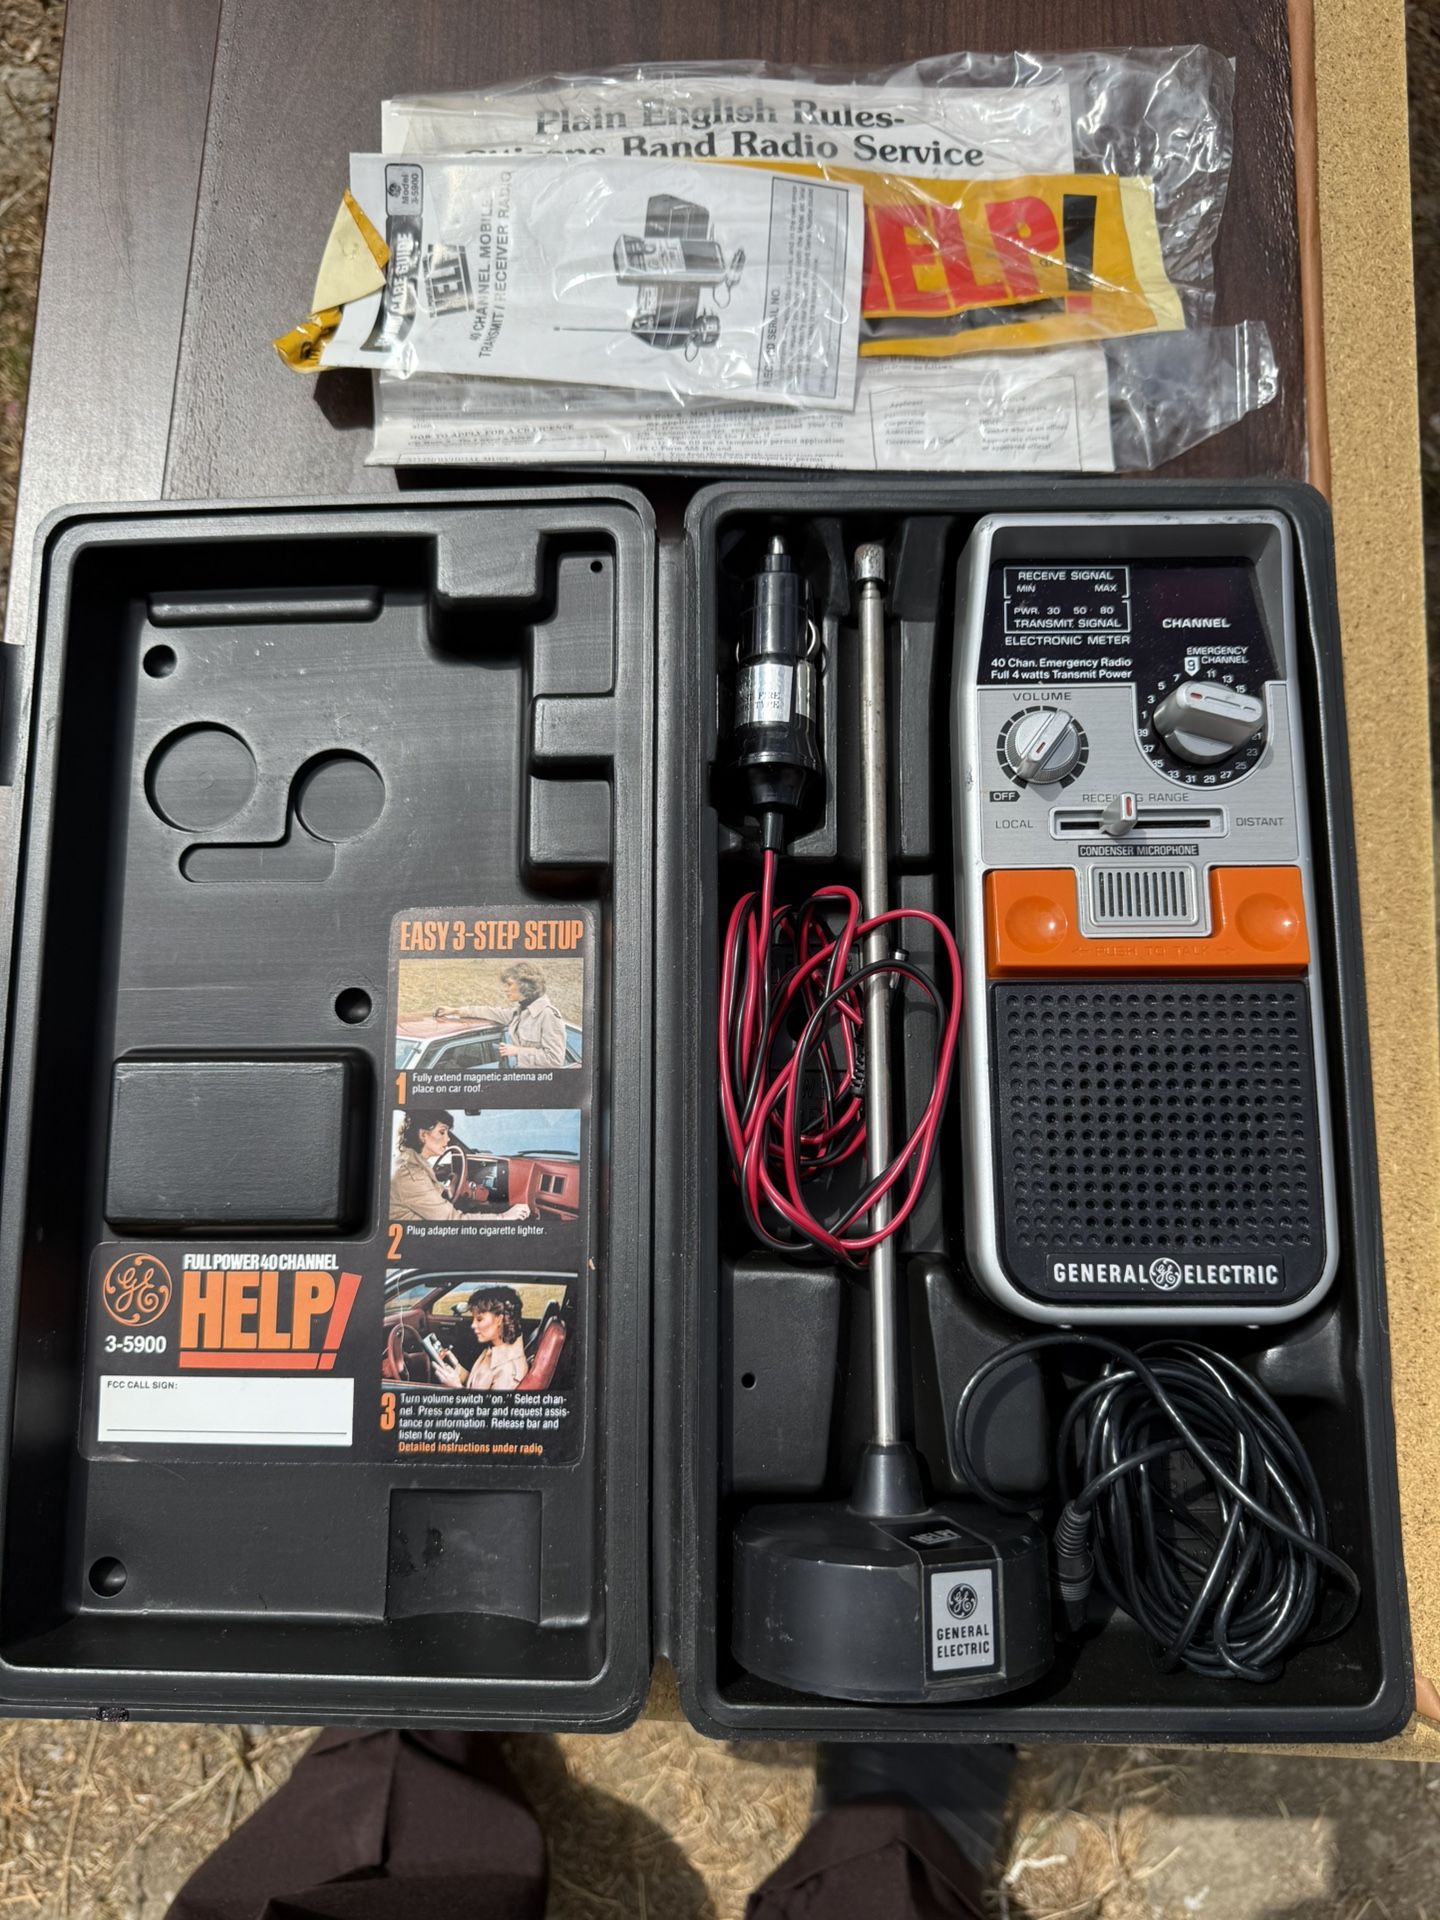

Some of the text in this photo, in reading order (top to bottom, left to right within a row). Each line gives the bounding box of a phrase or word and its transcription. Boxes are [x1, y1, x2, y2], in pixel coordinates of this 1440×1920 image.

[536, 97, 905, 135] Plain English Rules-
[622, 130, 984, 167] Band Radio Service
[497, 171, 513, 219] RADIO
[480, 197, 493, 258] MOBILE
[395, 232, 412, 276] GUIDE
[863, 196, 1097, 315] ELP!
[494, 225, 509, 302] RECEIVER
[474, 264, 491, 331] CHANNEL
[478, 312, 504, 358] TRANSMIT
[1018, 571, 1115, 581] RECEIVE SIGNAL
[1016, 584, 1036, 593] MIN
[1094, 584, 1117, 593] MAX
[1046, 605, 1061, 615] 30
[1073, 605, 1088, 615] 50
[1100, 605, 1114, 615] 80
[1014, 618, 1122, 629] TRANSMIT SIGNAL
[1161, 617, 1232, 629] CHANNEL
[1005, 635, 1131, 647] ELECTRONIC METER
[1186, 645, 1248, 656] EMERGENCY
[990, 657, 1133, 671] 40 Chan. Emergency Radio
[1187, 659, 1197, 671] 9
[1201, 656, 1249, 665] CHANNEL
[991, 669, 1133, 680] Full 4 watts Transmit Power
[1173, 673, 1181, 682] 7
[1206, 670, 1217, 678] 11
[1222, 674, 1233, 683] 13
[1158, 682, 1166, 691] 5
[1236, 685, 1246, 694] 15
[1012, 692, 1072, 702] VOLUME
[1147, 695, 1155, 704] 3
[1142, 711, 1147, 719] 1
[1137, 728, 1149, 737] 39
[1144, 744, 1155, 753] 37
[1246, 748, 1259, 757] 23
[1152, 759, 1164, 768] 35
[1235, 761, 1247, 770] 25
[1168, 770, 1180, 779] 33
[1185, 775, 1197, 784] 31
[1203, 775, 1216, 785] 29
[1220, 771, 1232, 780] 27
[993, 791, 1017, 802] OFF
[1148, 792, 1190, 802] RANGE
[995, 819, 1034, 829] LOCAL
[1236, 817, 1284, 827] DISTANT
[1080, 845, 1198, 856] CONDENSER MICROPHONE
[400, 919, 584, 951] EASY 3-STEP SETUP
[395, 1071, 553, 1105] 1 Fully extend magnetic antenna and
[412, 1084, 434, 1094] place
[463, 1084, 483, 1093] roof.
[387, 1223, 547, 1260] 2 Plug adapter into cigarette lighter.
[184, 1254, 339, 1271] FULL POWER 40 CHANNEL
[1053, 1262, 1148, 1283] GENERAL
[1184, 1264, 1278, 1284] ELECTRIC
[179, 1270, 363, 1369] HELP!
[105, 1335, 167, 1353] 3-5900
[107, 1381, 178, 1390] FCC CALL SIGN:
[380, 1391, 396, 1431] 3
[400, 1393, 420, 1404] Turn
[422, 1393, 454, 1404] volume
[455, 1393, 483, 1404] switch
[514, 1393, 540, 1404] Select
[542, 1393, 567, 1404] chan-
[418, 1406, 443, 1416] Press
[444, 1407, 475, 1418] orange
[476, 1407, 490, 1416] bar
[492, 1407, 508, 1416] and
[510, 1407, 543, 1418] request
[544, 1407, 570, 1417] assis-
[399, 1418, 559, 1429] tance or information. Release bar and
[399, 1430, 463, 1442] listen for reply.
[399, 1442, 436, 1452] Detailed
[438, 1442, 490, 1453] instructions
[492, 1443, 518, 1453] under
[936, 1623, 990, 1641] GENERAL
[937, 1641, 990, 1658] ELECTRIC
